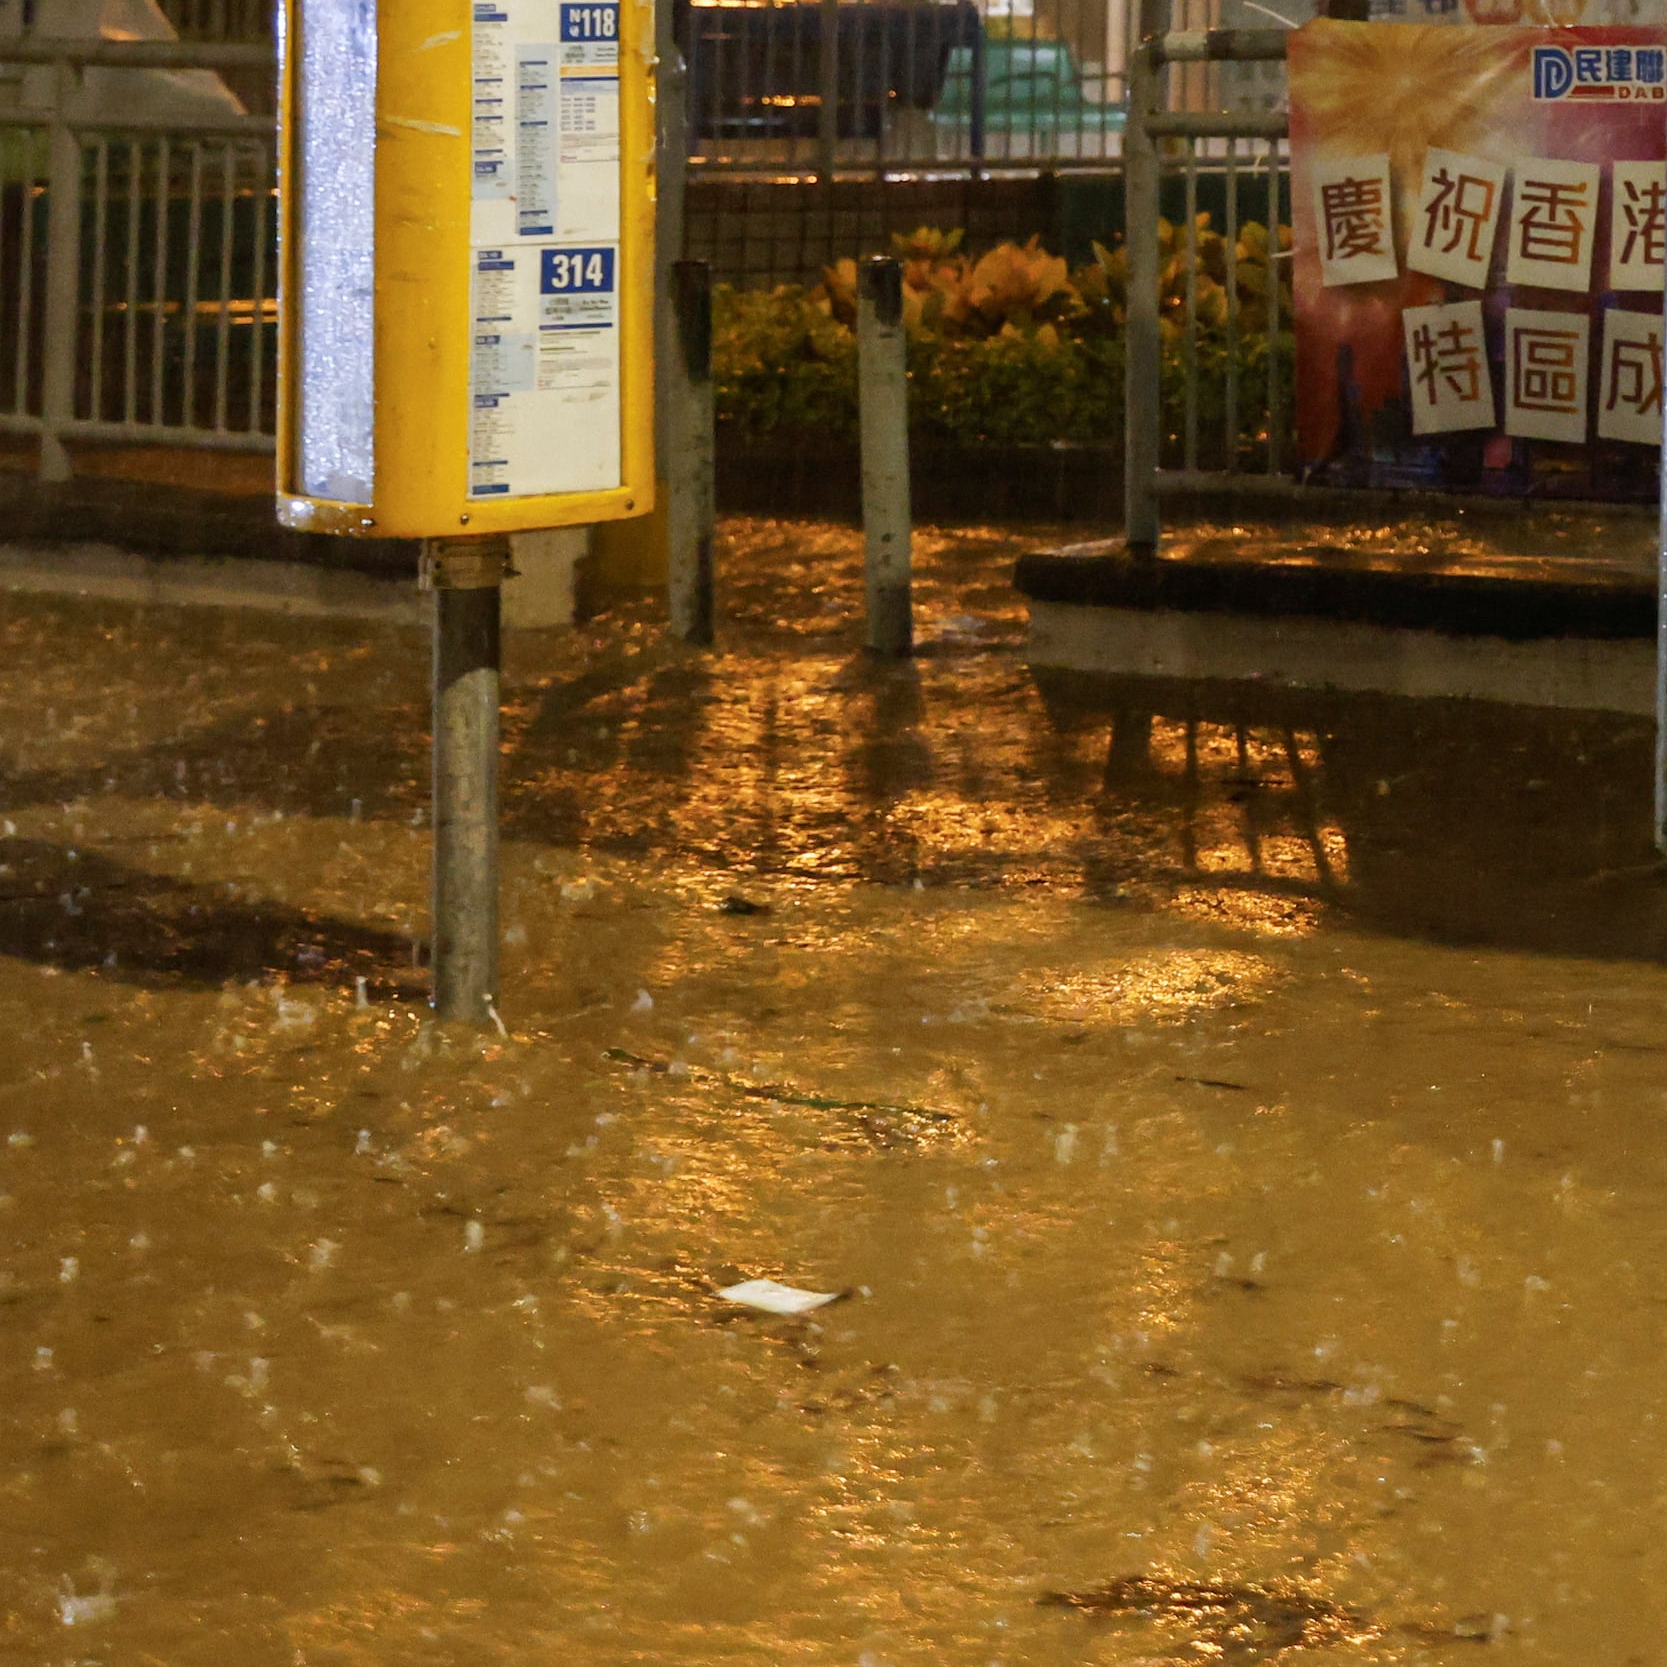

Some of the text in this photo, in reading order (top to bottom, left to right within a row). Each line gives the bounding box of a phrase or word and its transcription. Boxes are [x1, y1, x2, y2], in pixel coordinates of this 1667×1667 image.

[569, 8, 615, 37] N118
[1575, 49, 1665, 83] 民建聯
[1619, 86, 1664, 99] DAB
[1322, 167, 1667, 265] 慶祝香港
[551, 253, 603, 289] 314
